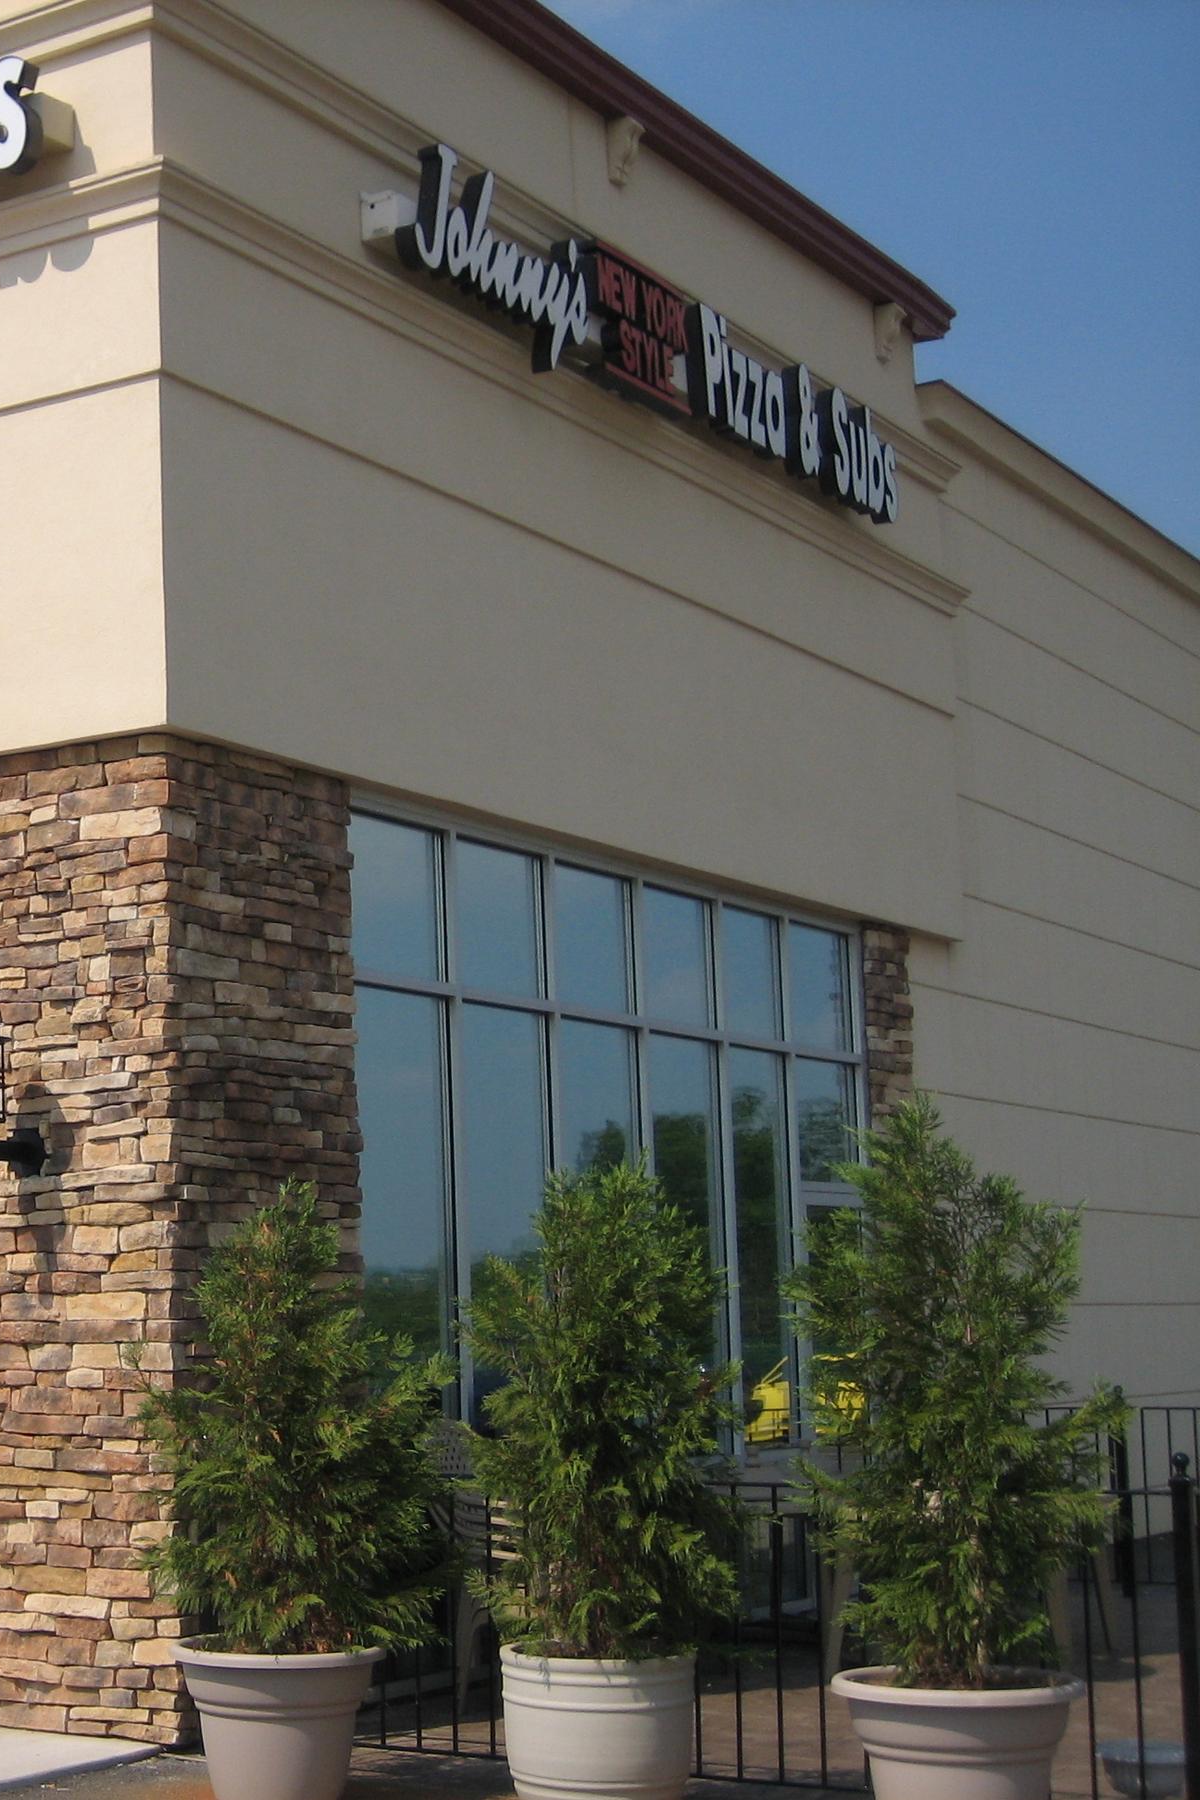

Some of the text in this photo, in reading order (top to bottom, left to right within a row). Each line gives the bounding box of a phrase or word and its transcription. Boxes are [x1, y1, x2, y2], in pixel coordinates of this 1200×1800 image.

[415, 143, 589, 371] Johnny's
[596, 254, 688, 353] NEW YORK
[620, 320, 675, 393] STYLE
[700, 303, 898, 524] Pizza & Subs
